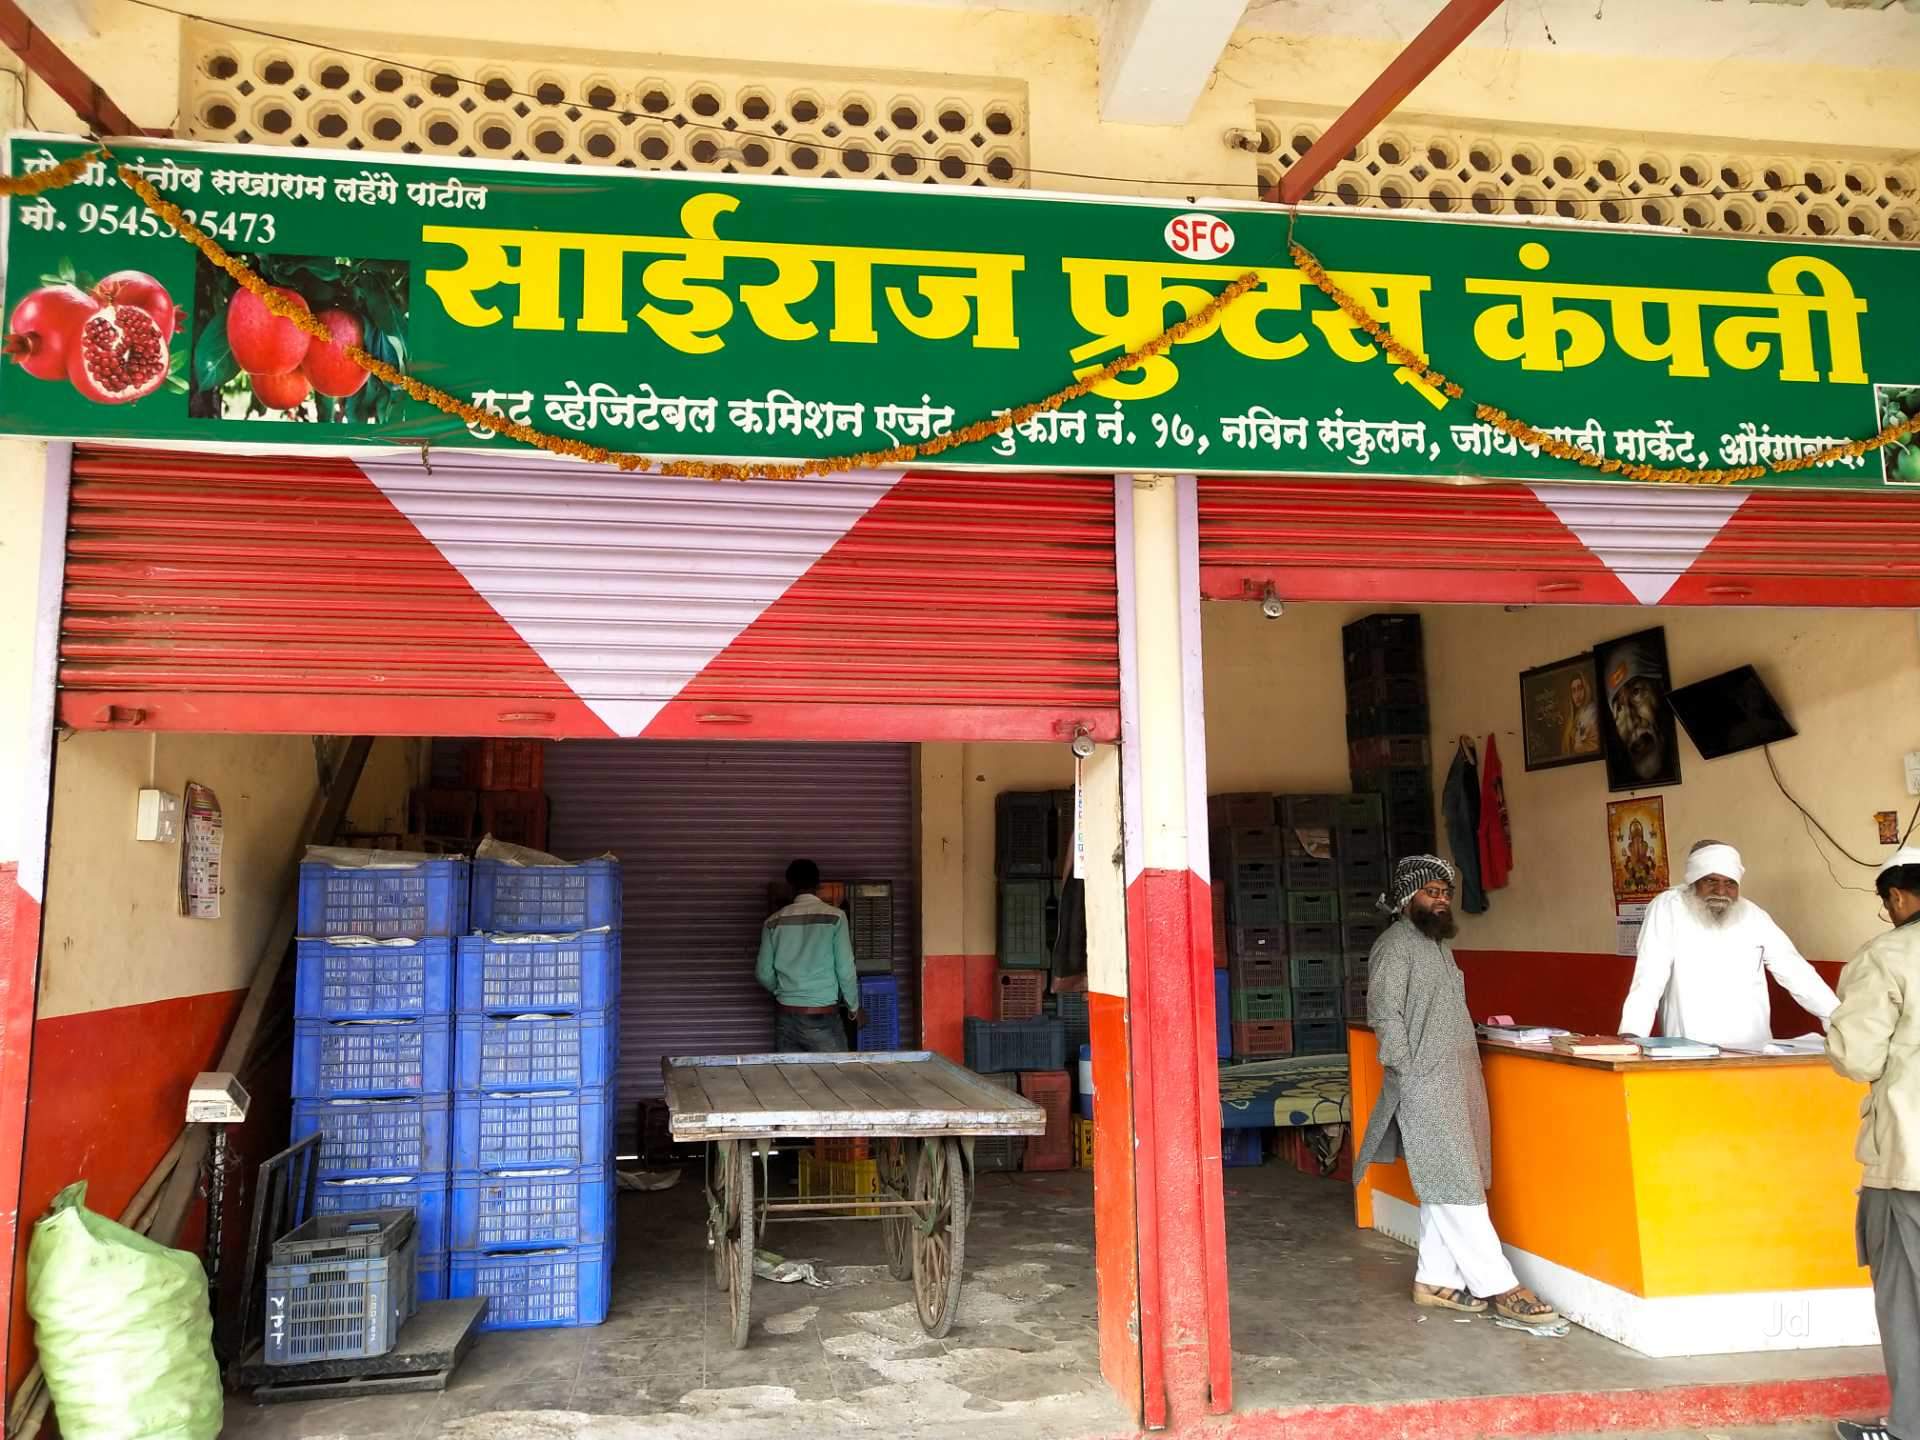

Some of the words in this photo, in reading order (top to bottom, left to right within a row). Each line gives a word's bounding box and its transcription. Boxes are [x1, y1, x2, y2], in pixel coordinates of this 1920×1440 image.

[211, 169, 327, 200] सखाराम
[406, 177, 489, 210] पाटील
[20, 197, 66, 231] मो.
[1170, 218, 1231, 256] SFC
[422, 193, 1025, 354] साईराज
[1465, 243, 1868, 384] कंपनी
[543, 380, 719, 433] व्हेजिटेबल
[727, 389, 865, 439] कमिशन
[873, 394, 955, 449] एजंट
[1095, 400, 1137, 445] नं.
[1151, 413, 1210, 455] १७,
[1219, 405, 1309, 450] नविन
[1316, 407, 1441, 466] संकुलन,
